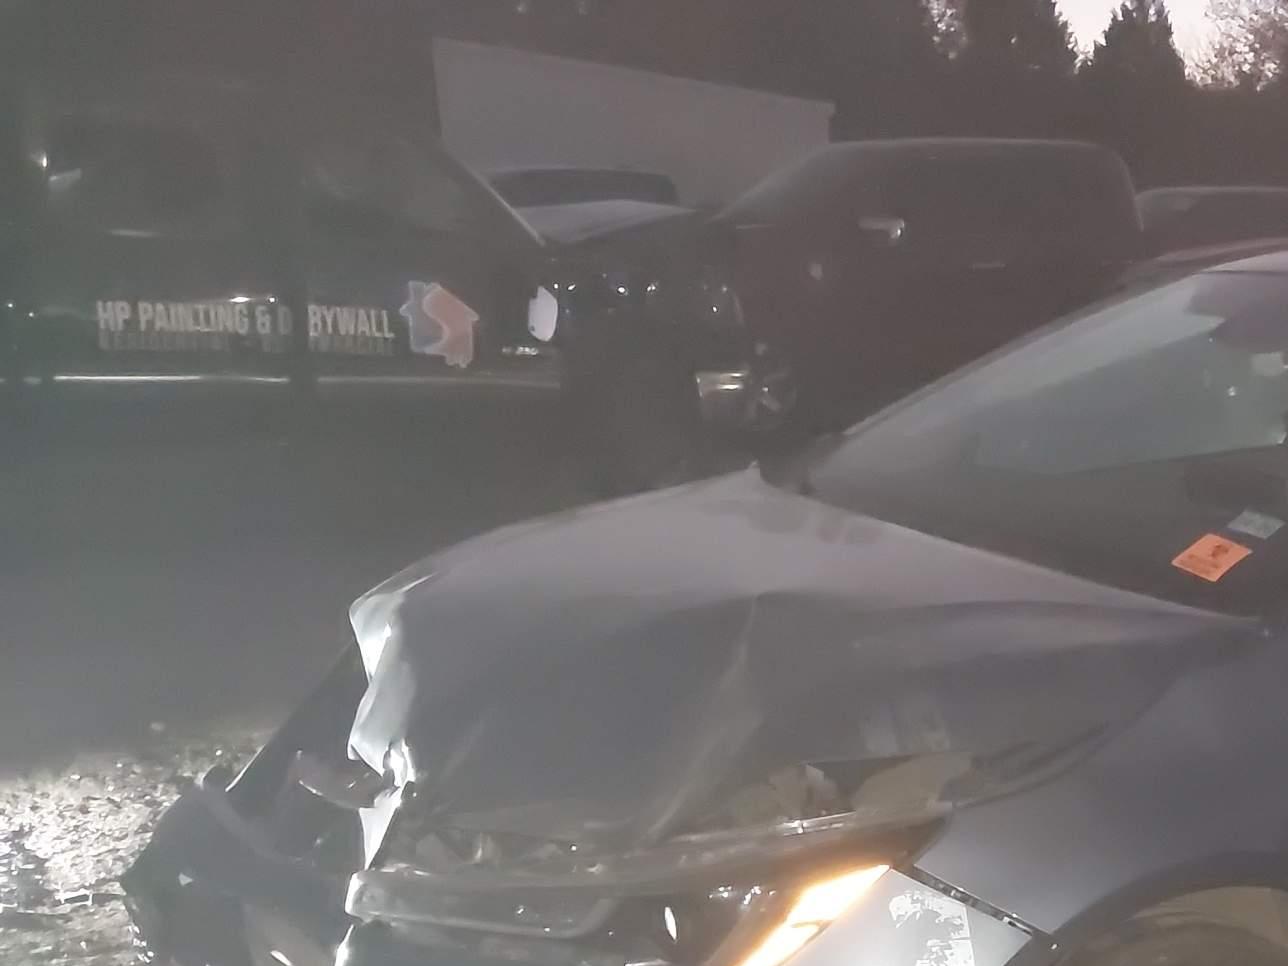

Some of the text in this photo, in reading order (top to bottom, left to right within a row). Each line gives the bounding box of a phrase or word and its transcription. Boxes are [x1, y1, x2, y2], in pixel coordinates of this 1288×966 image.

[97, 300, 131, 331] HP
[138, 301, 249, 335] PAINTING
[255, 304, 272, 335] &
